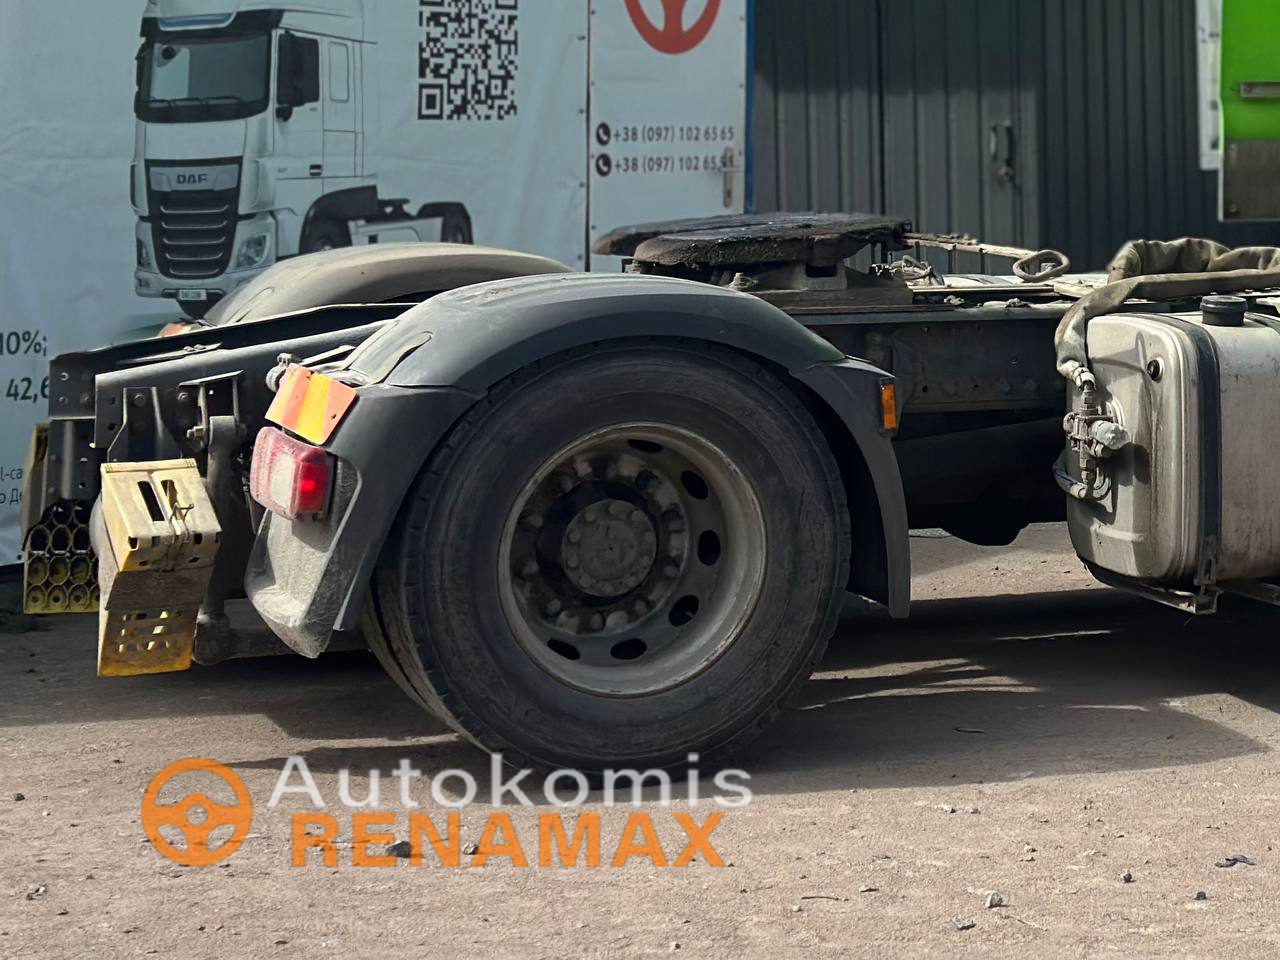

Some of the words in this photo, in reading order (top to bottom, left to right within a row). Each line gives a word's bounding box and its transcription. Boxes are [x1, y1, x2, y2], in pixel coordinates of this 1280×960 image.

[613, 126, 638, 141] +38
[641, 125, 674, 144] (097)
[679, 126, 700, 141] 102
[615, 157, 638, 172] +38
[641, 156, 674, 174] (097)
[679, 156, 699, 171] 102
[176, 173, 207, 185] DAF
